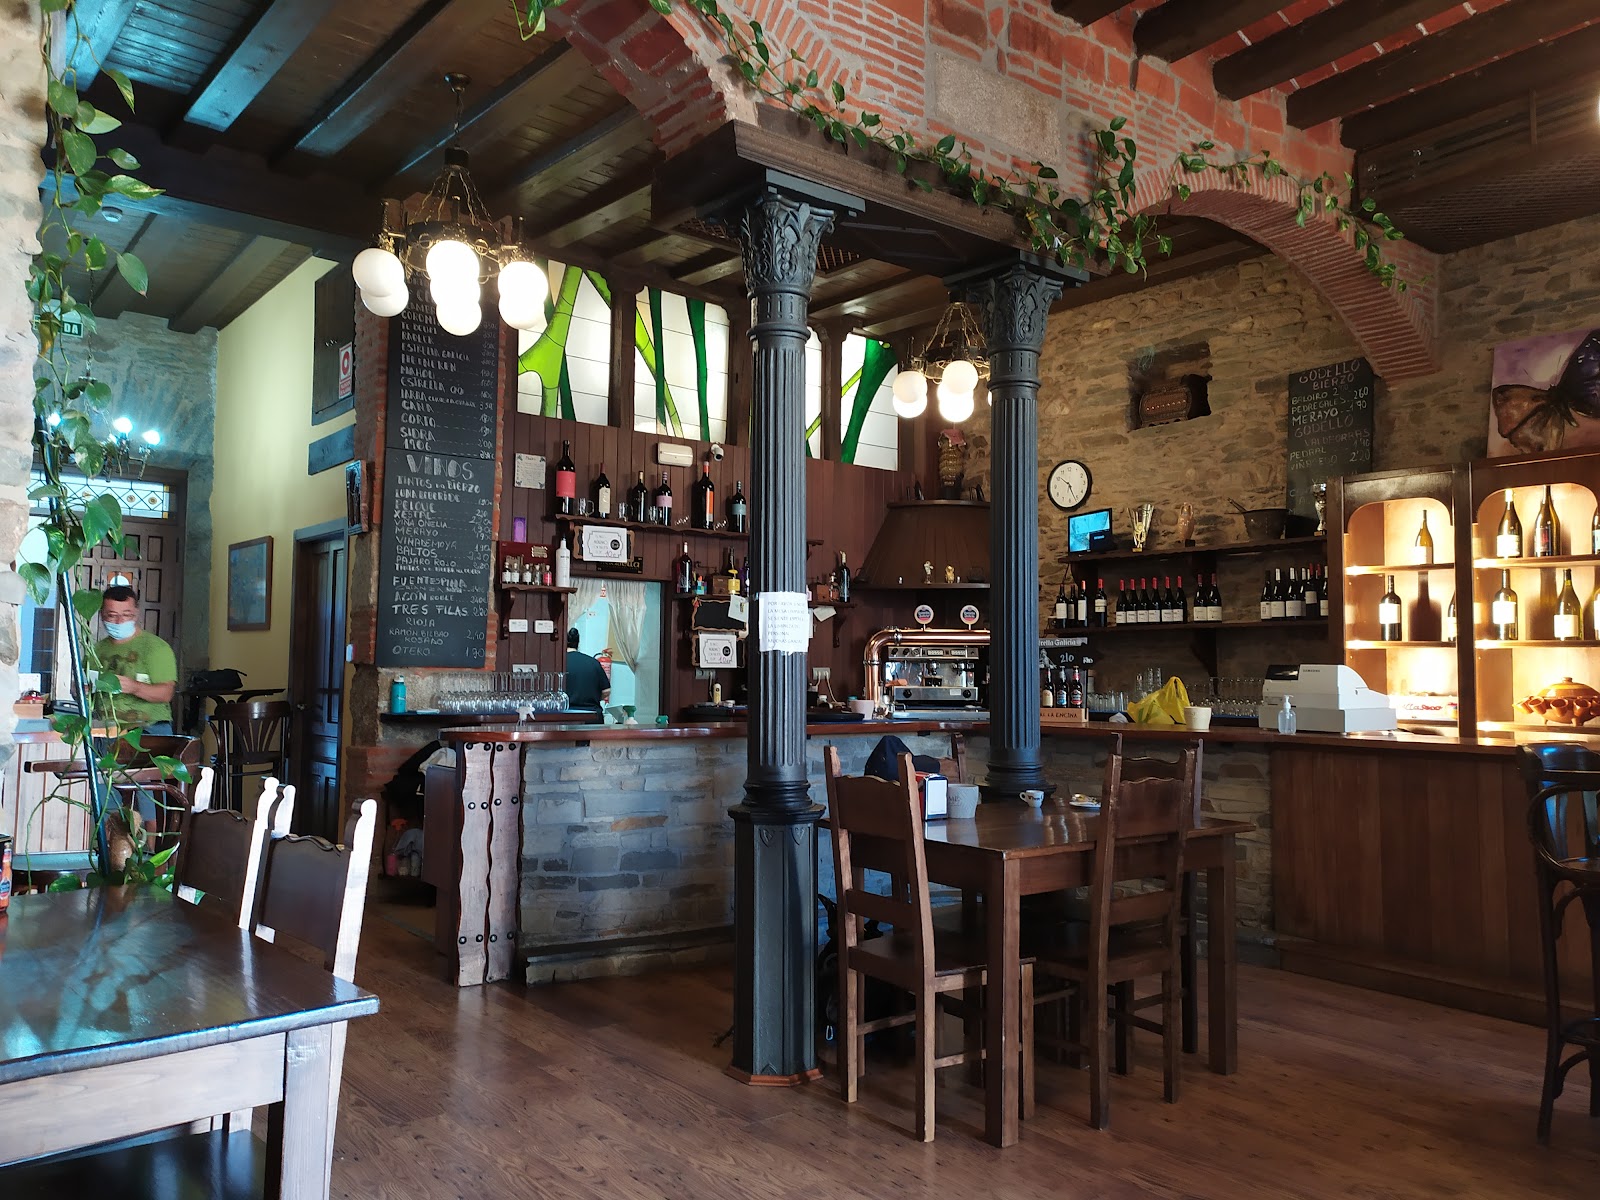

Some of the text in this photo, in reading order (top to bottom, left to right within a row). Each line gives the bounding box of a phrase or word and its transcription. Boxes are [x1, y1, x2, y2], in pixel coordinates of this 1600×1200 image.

[1299, 359, 1360, 384] GODELLO
[1313, 373, 1354, 391] BIERZO
[1291, 391, 1328, 405] BALOIRO
[1291, 396, 1347, 415] PEDREGALES
[1292, 407, 1339, 426] MERAYO
[1294, 414, 1354, 438] GODELLO
[400, 426, 436, 442] SIDRA
[403, 438, 431, 451] 1906
[1290, 446, 1327, 462] PEDRAL
[406, 454, 474, 480] VINOS
[395, 488, 417, 499] LUNA
[447, 480, 480, 494] BIERZO
[393, 510, 432, 520] XESTAL
[418, 519, 448, 528] ONELIA
[395, 526, 438, 537] MERAYO
[396, 545, 438, 558] BALTOS
[396, 555, 431, 566] PAJARO
[434, 558, 457, 567] ROJO
[392, 604, 429, 615] TRES
[436, 604, 468, 617] FILAS
[405, 616, 435, 627] RIOJA
[404, 637, 443, 646] ROSADO
[392, 645, 431, 656] OTERO
